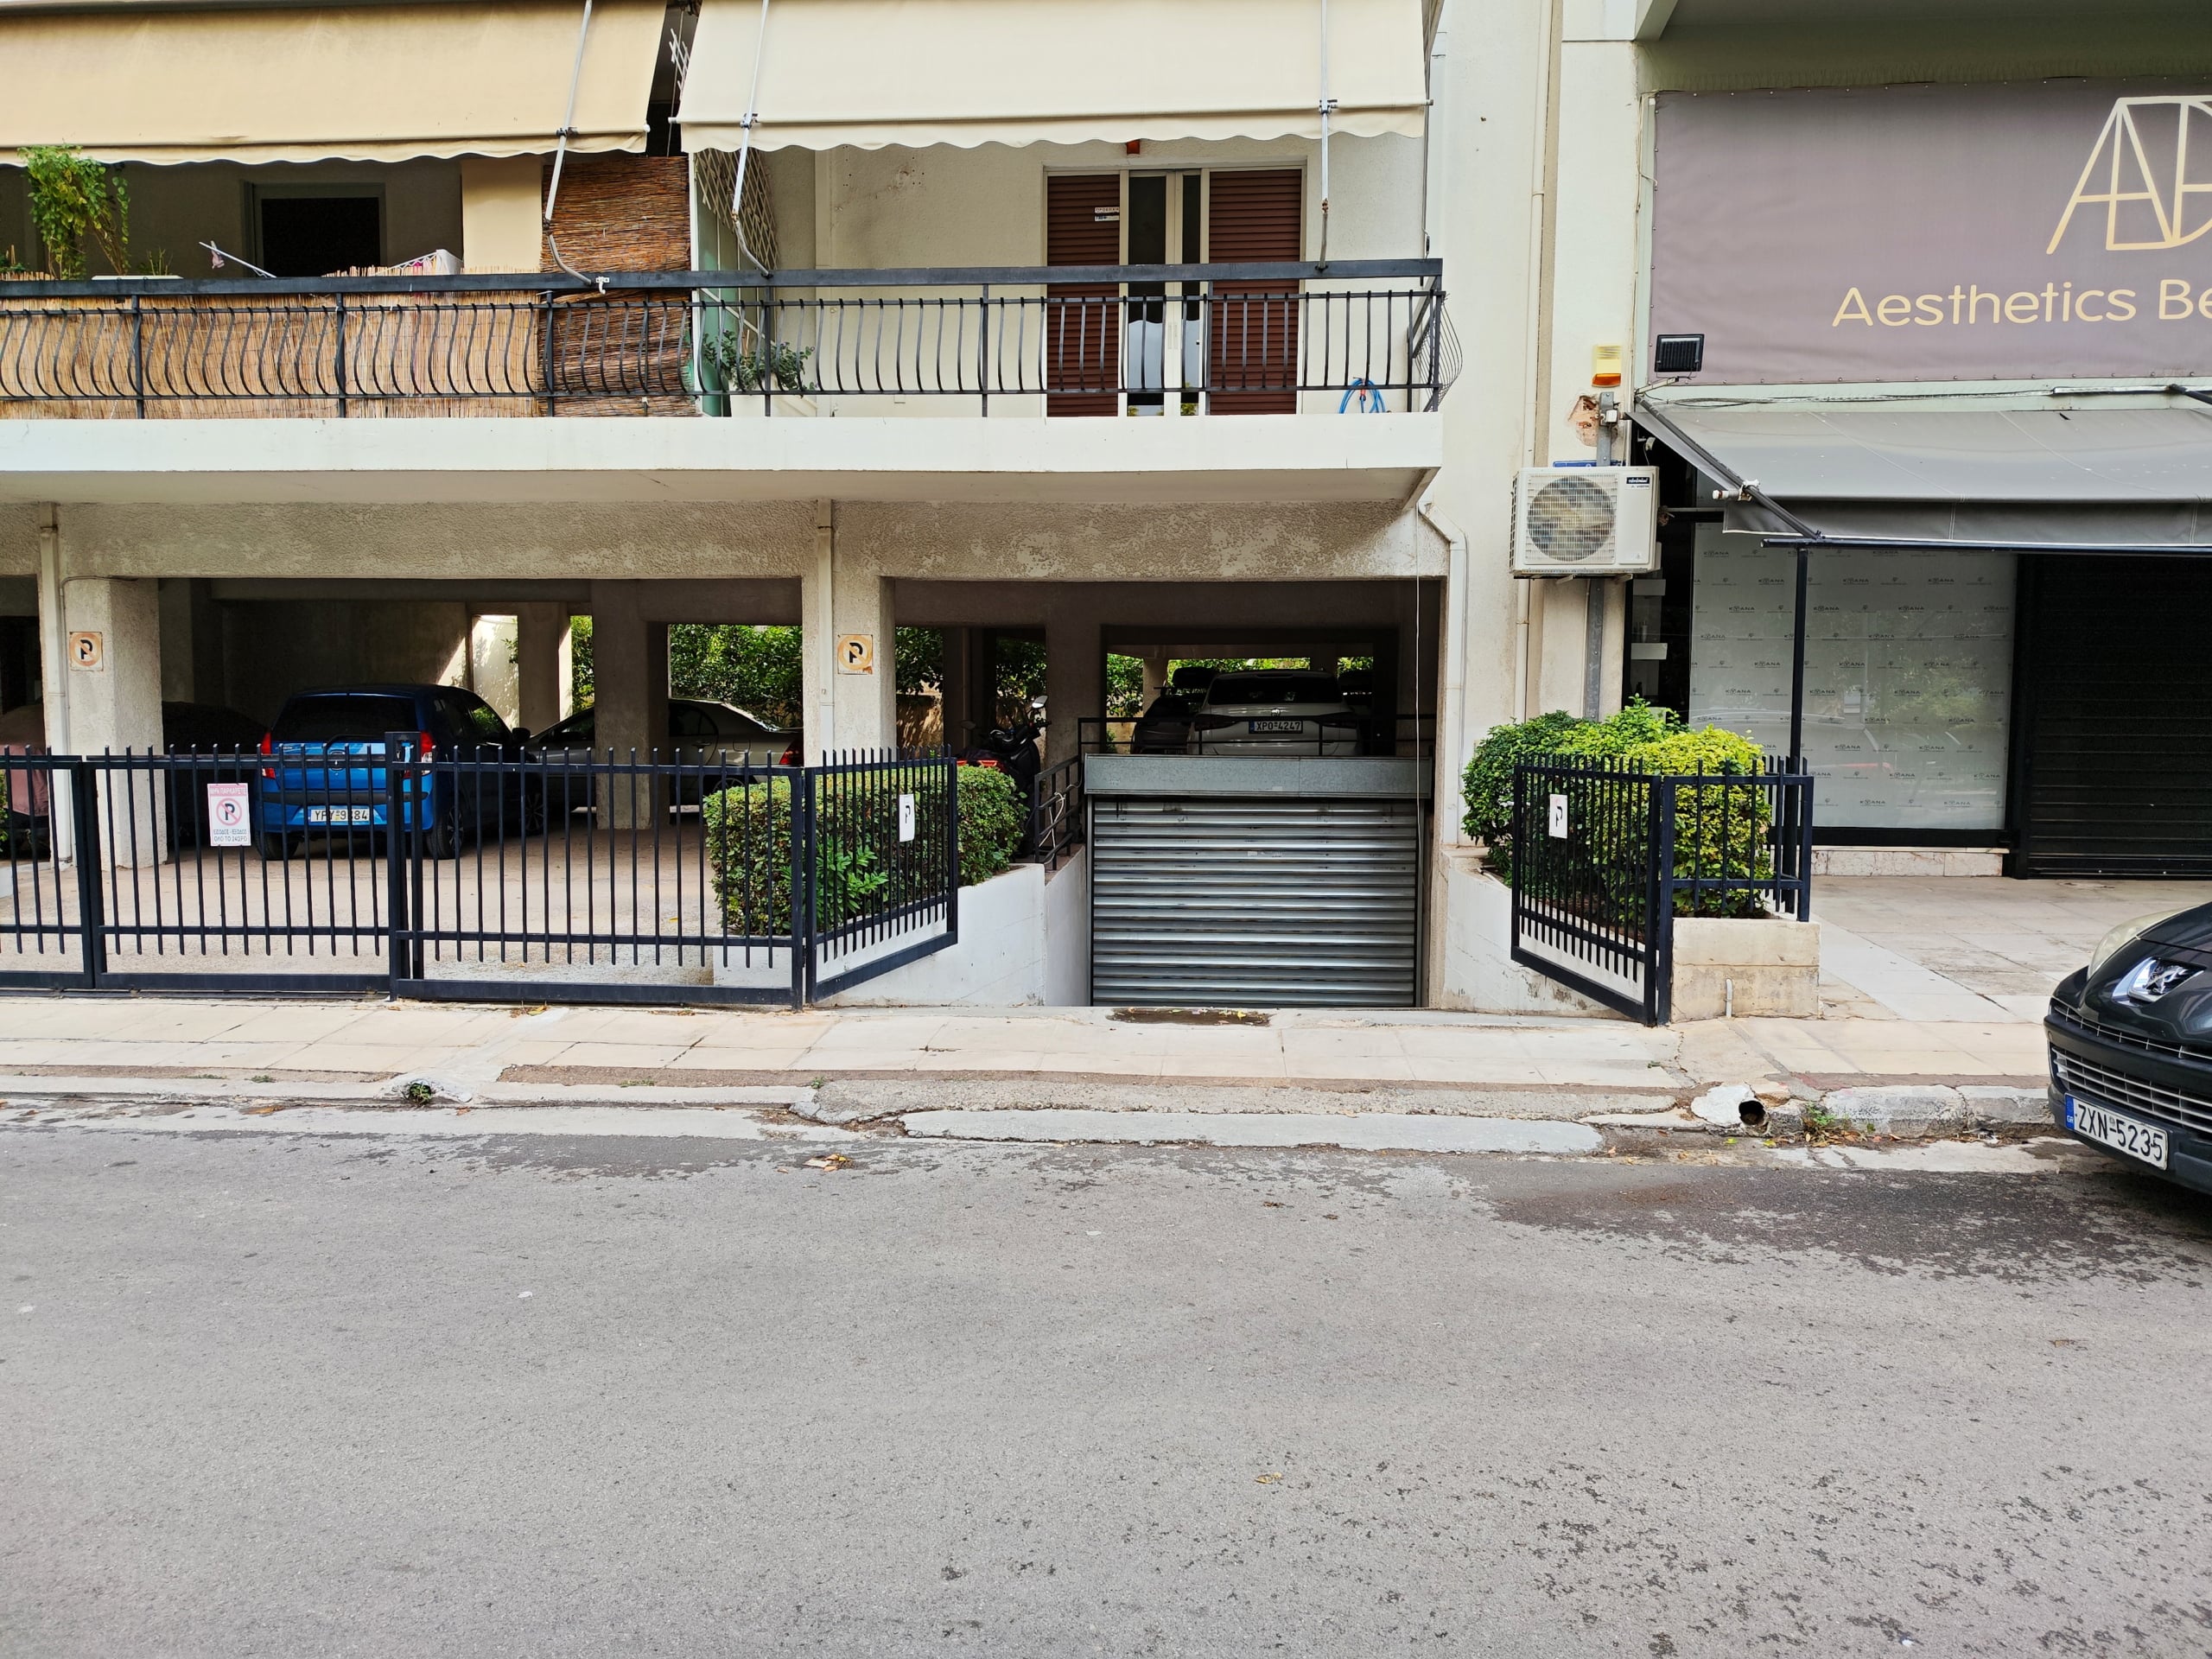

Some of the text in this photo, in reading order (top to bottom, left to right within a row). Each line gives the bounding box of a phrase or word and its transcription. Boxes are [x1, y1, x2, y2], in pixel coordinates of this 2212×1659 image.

[1832, 281, 2136, 327] Aesthetics
[80, 639, 92, 659] P
[849, 642, 863, 663] P
[225, 804, 235, 820] P
[2078, 1103, 2163, 1161] ZXN-5235
